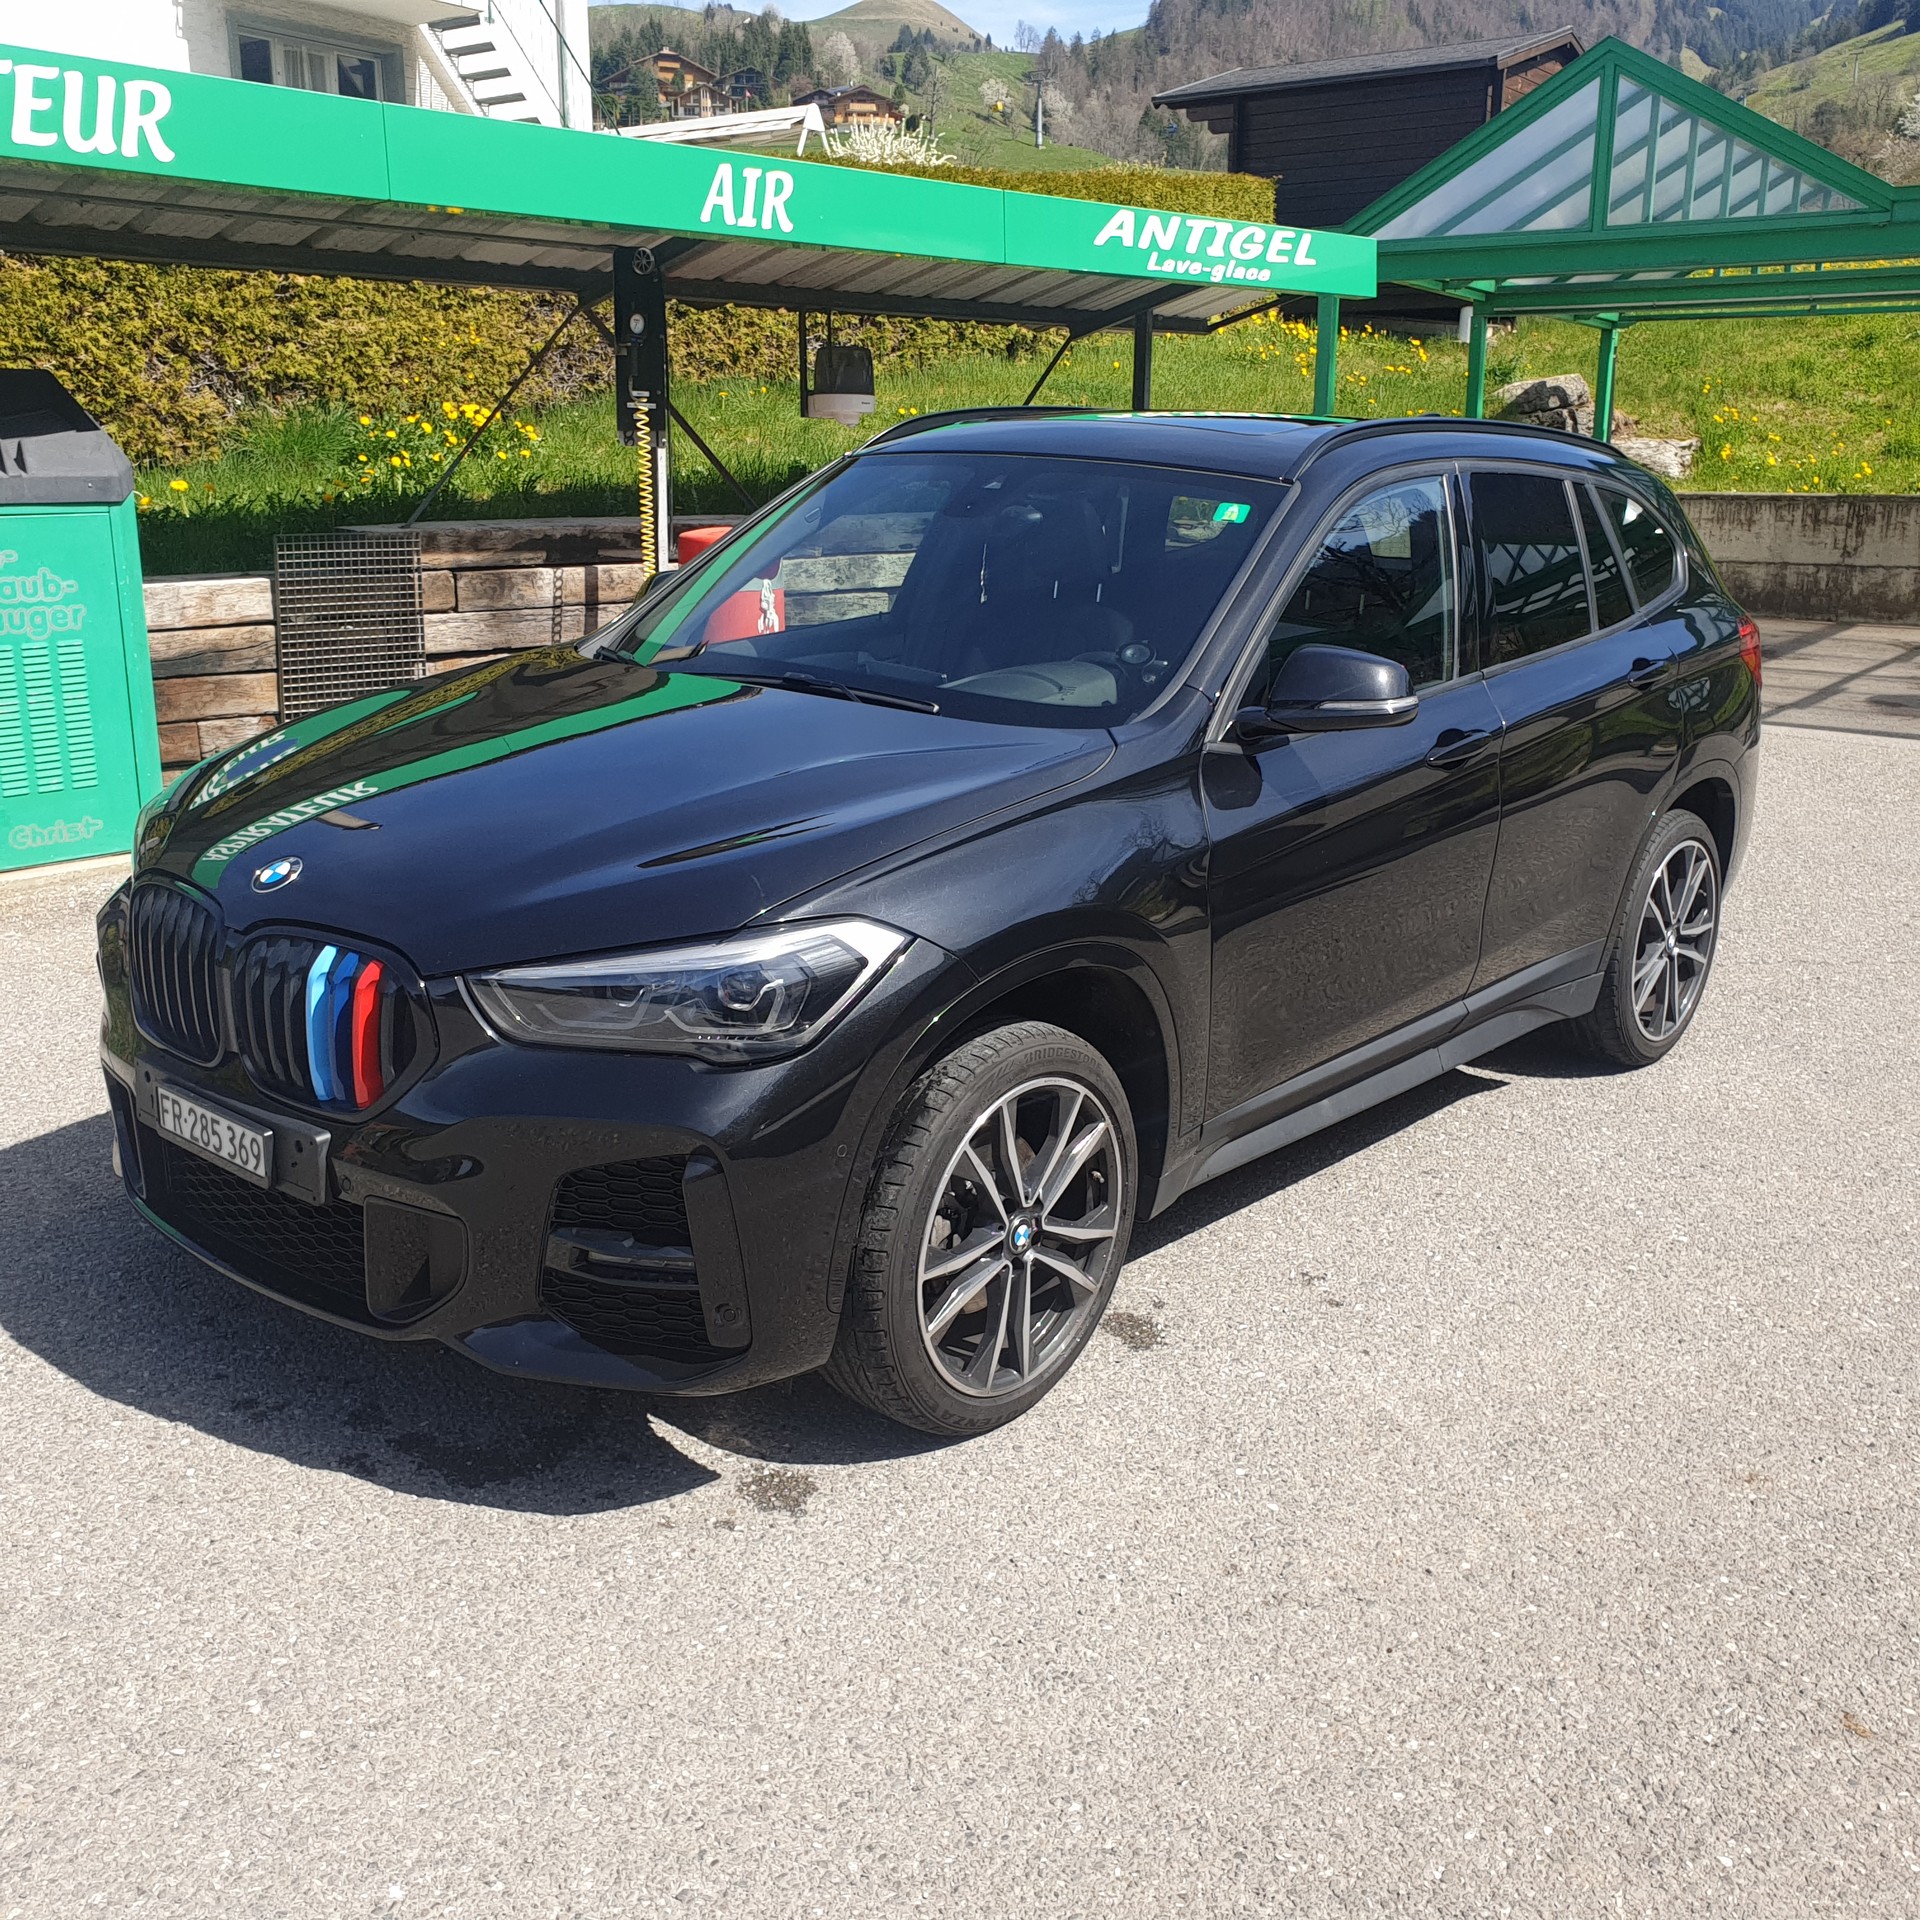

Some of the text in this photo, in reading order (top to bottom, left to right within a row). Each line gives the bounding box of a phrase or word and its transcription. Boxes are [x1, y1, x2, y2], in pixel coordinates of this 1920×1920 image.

[0, 59, 176, 163] EUR
[700, 163, 794, 233] AIR
[1093, 209, 1317, 266] ANTIGEL
[1147, 251, 1272, 283] Lave-glace
